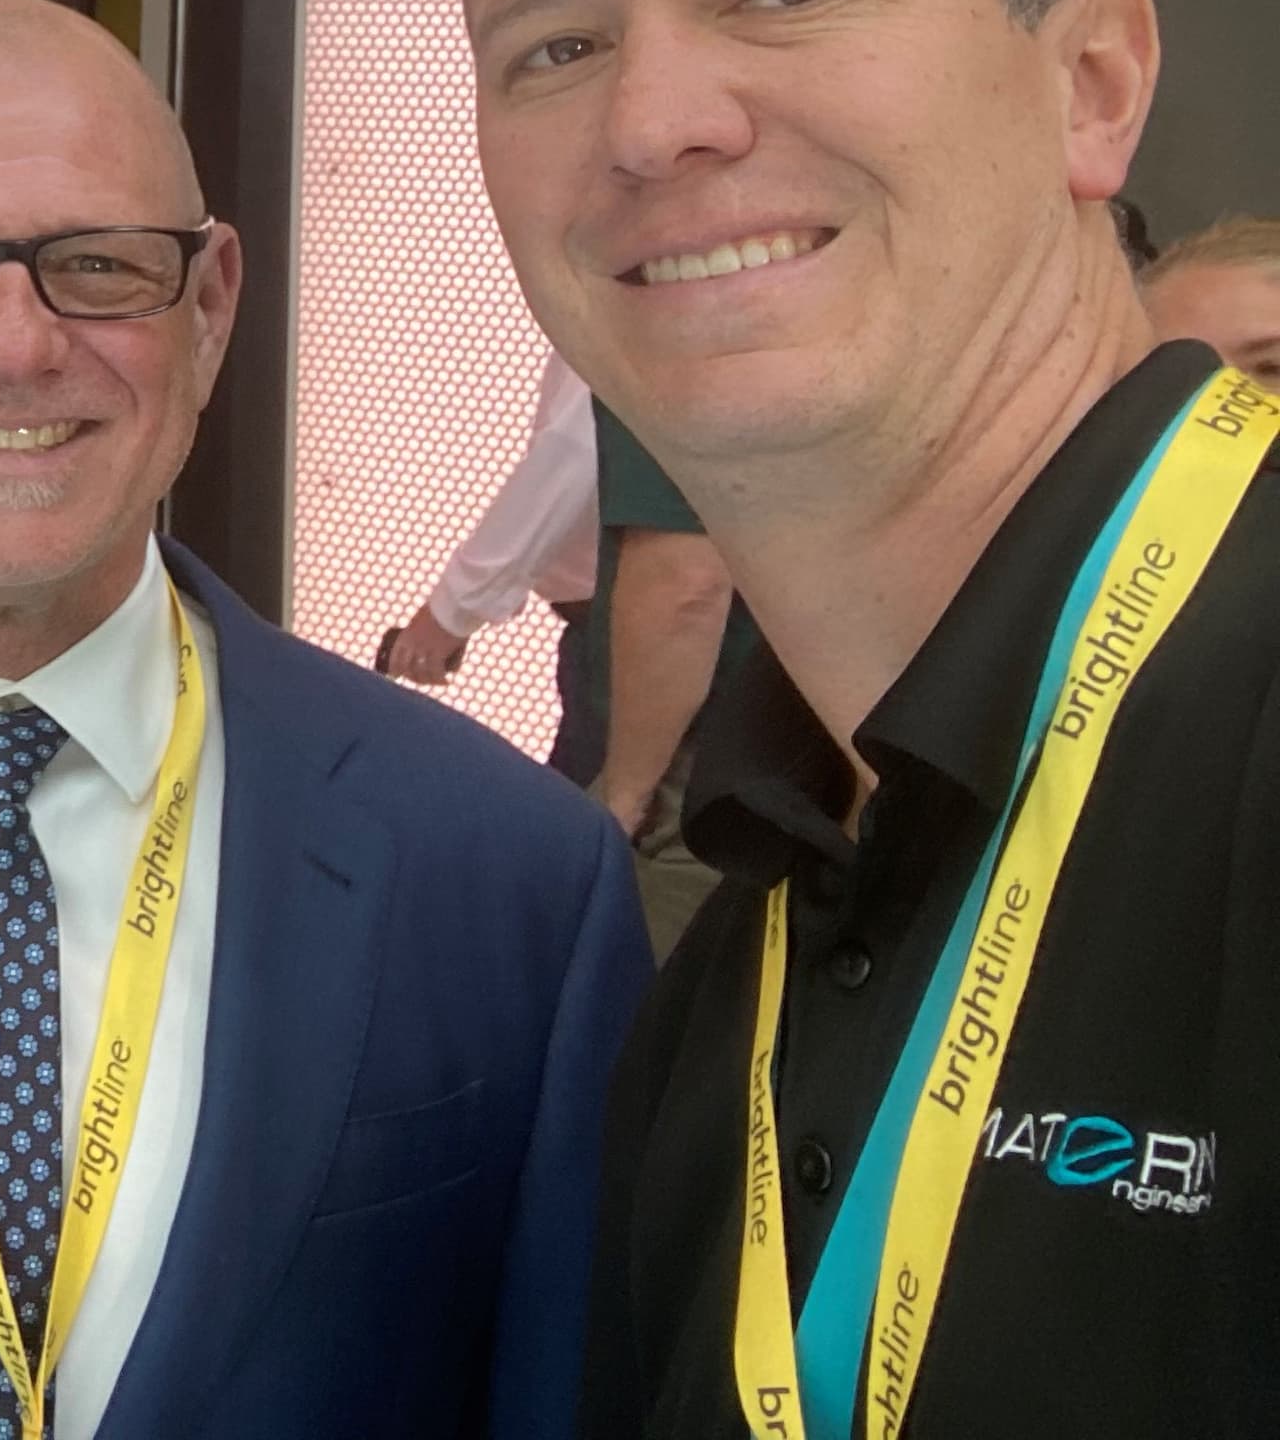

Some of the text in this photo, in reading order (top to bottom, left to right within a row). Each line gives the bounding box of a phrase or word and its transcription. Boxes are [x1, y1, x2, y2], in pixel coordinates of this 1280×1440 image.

[1052, 538, 1175, 741] brightline
[127, 778, 188, 939] brightline
[929, 878, 1031, 1116] brightline
[73, 1038, 131, 1215] brightline
[749, 1050, 773, 1247] brightline
